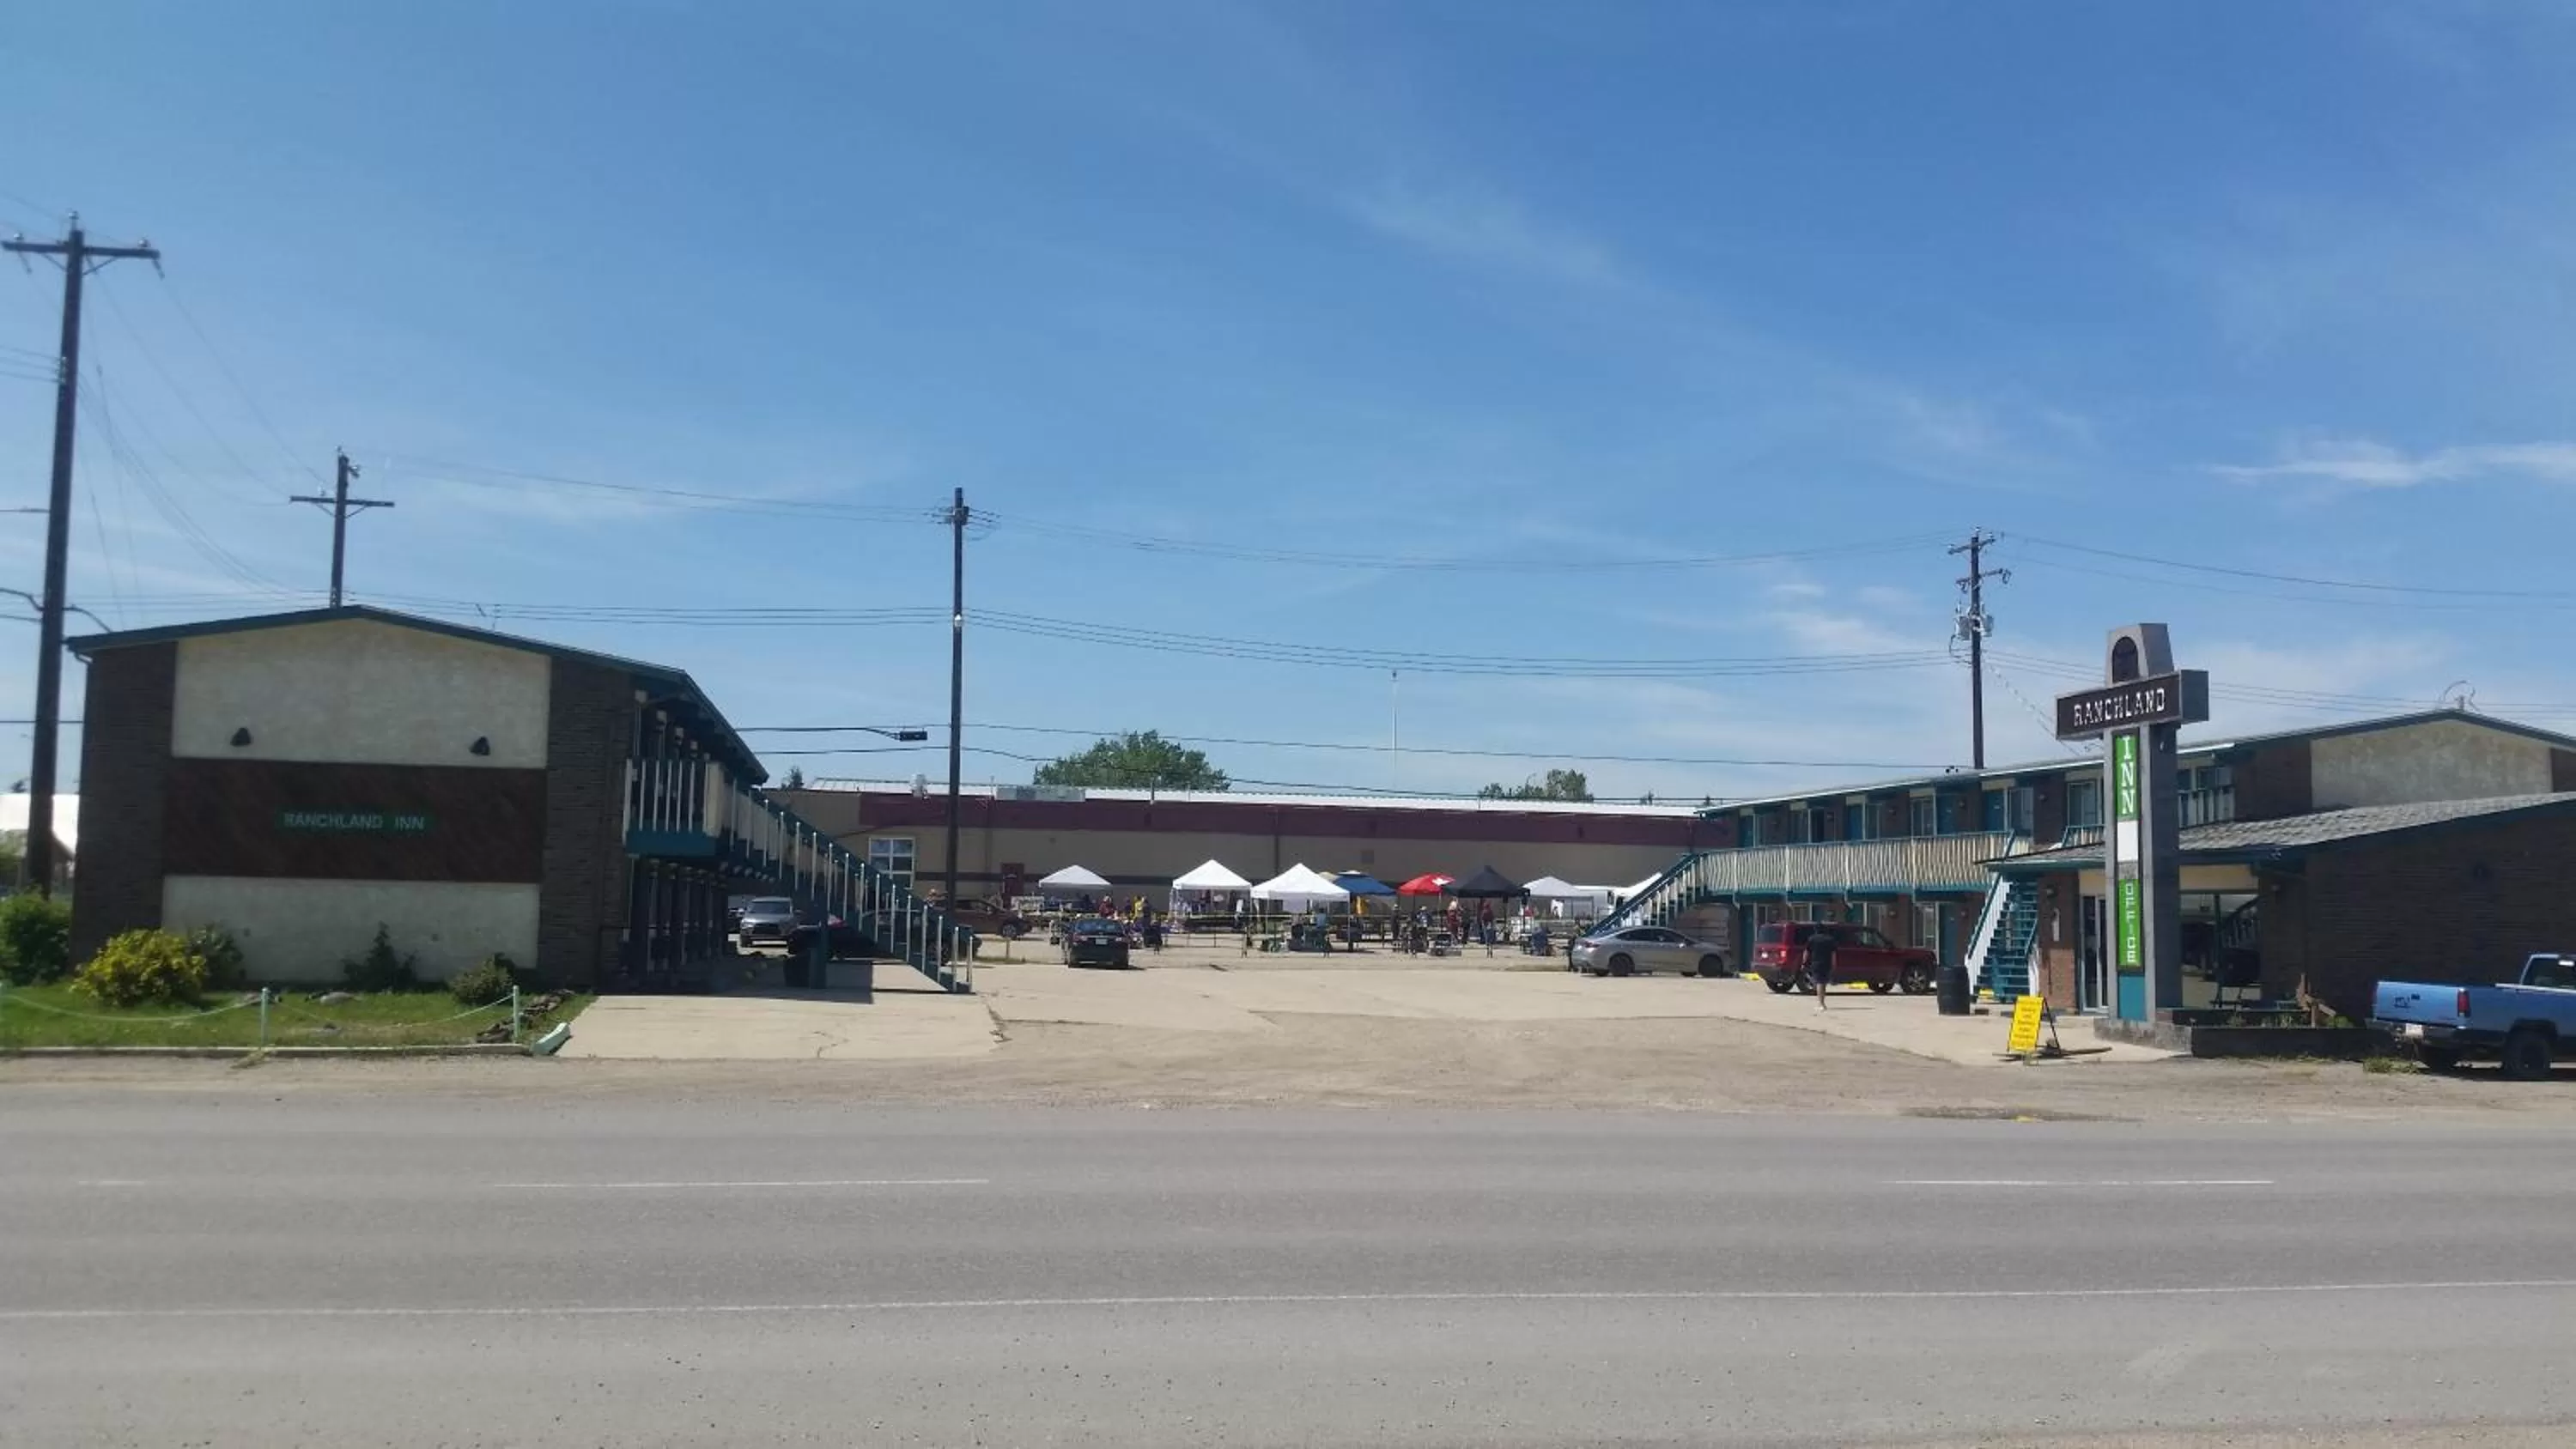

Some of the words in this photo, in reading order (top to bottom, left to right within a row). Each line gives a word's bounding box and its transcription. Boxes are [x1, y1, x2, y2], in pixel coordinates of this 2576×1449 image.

[2074, 688, 2165, 726] RANCHLAND
[2120, 736, 2135, 815] INN
[283, 812, 384, 829] RANCHLAND
[394, 815, 426, 830] INN
[2125, 882, 2136, 962] OFFICE
